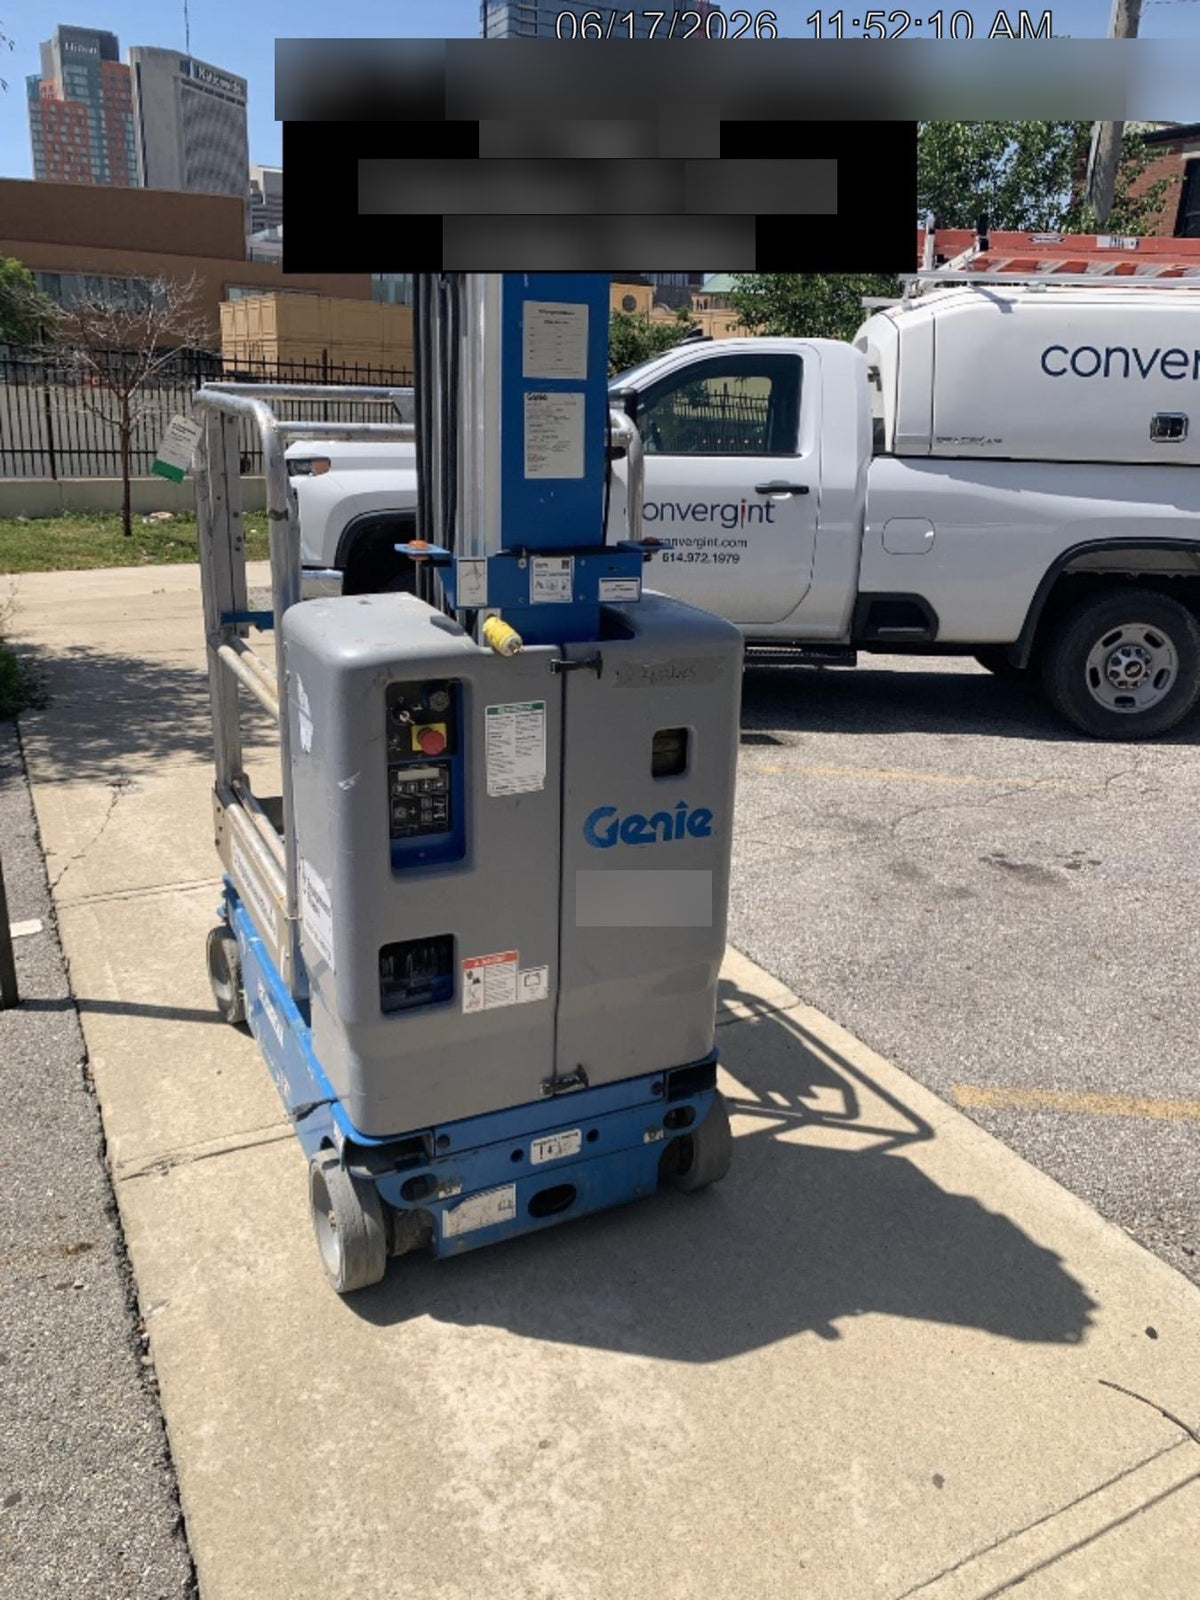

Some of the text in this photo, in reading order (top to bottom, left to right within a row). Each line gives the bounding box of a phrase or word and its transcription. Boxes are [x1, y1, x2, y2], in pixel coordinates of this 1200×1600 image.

[642, 498, 776, 530] onvergint
[661, 551, 741, 564] 614.972.1979
[582, 799, 714, 849] Genie
